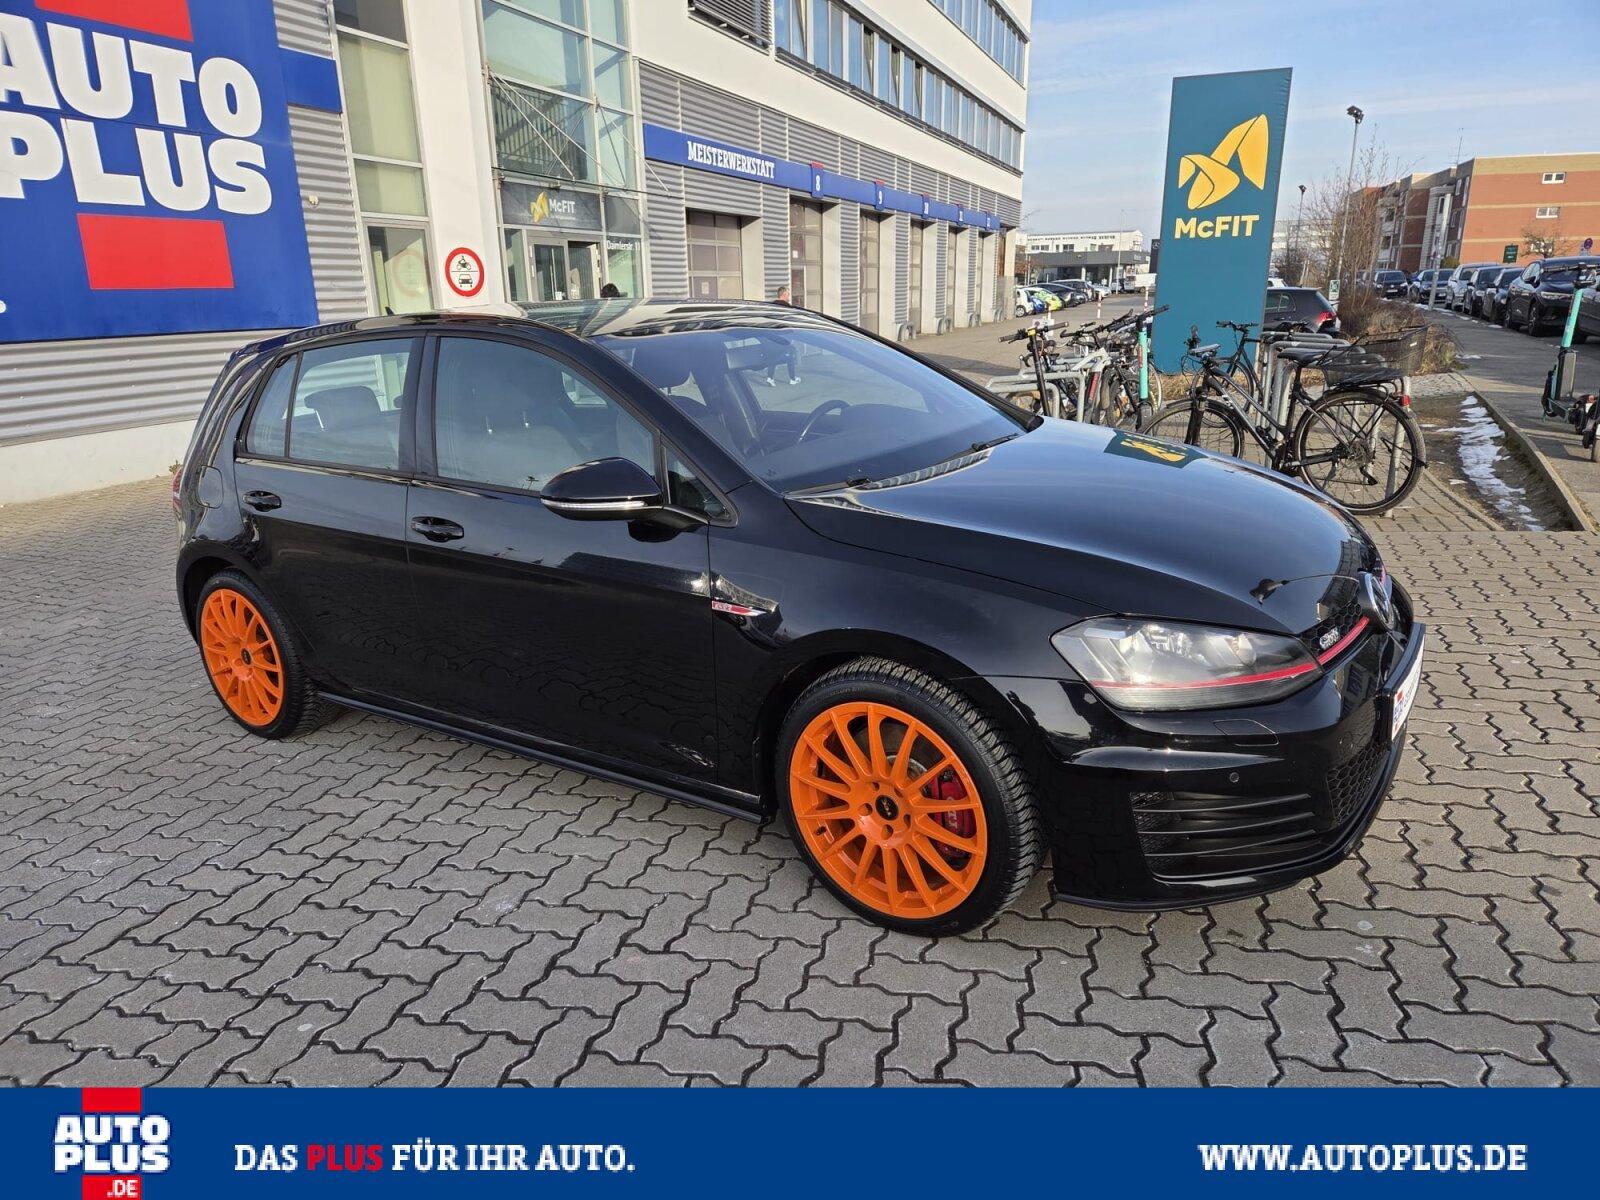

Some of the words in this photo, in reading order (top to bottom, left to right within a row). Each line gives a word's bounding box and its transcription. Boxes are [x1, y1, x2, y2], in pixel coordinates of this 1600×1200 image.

[0, 12, 262, 138] AUTO
[0, 110, 272, 215] PLUS
[687, 140, 775, 179] MEISTERWERKSTATT
[815, 174, 821, 192] 8
[549, 198, 576, 214] McFIT
[878, 190, 883, 205] 9
[1174, 214, 1260, 240] McFIT
